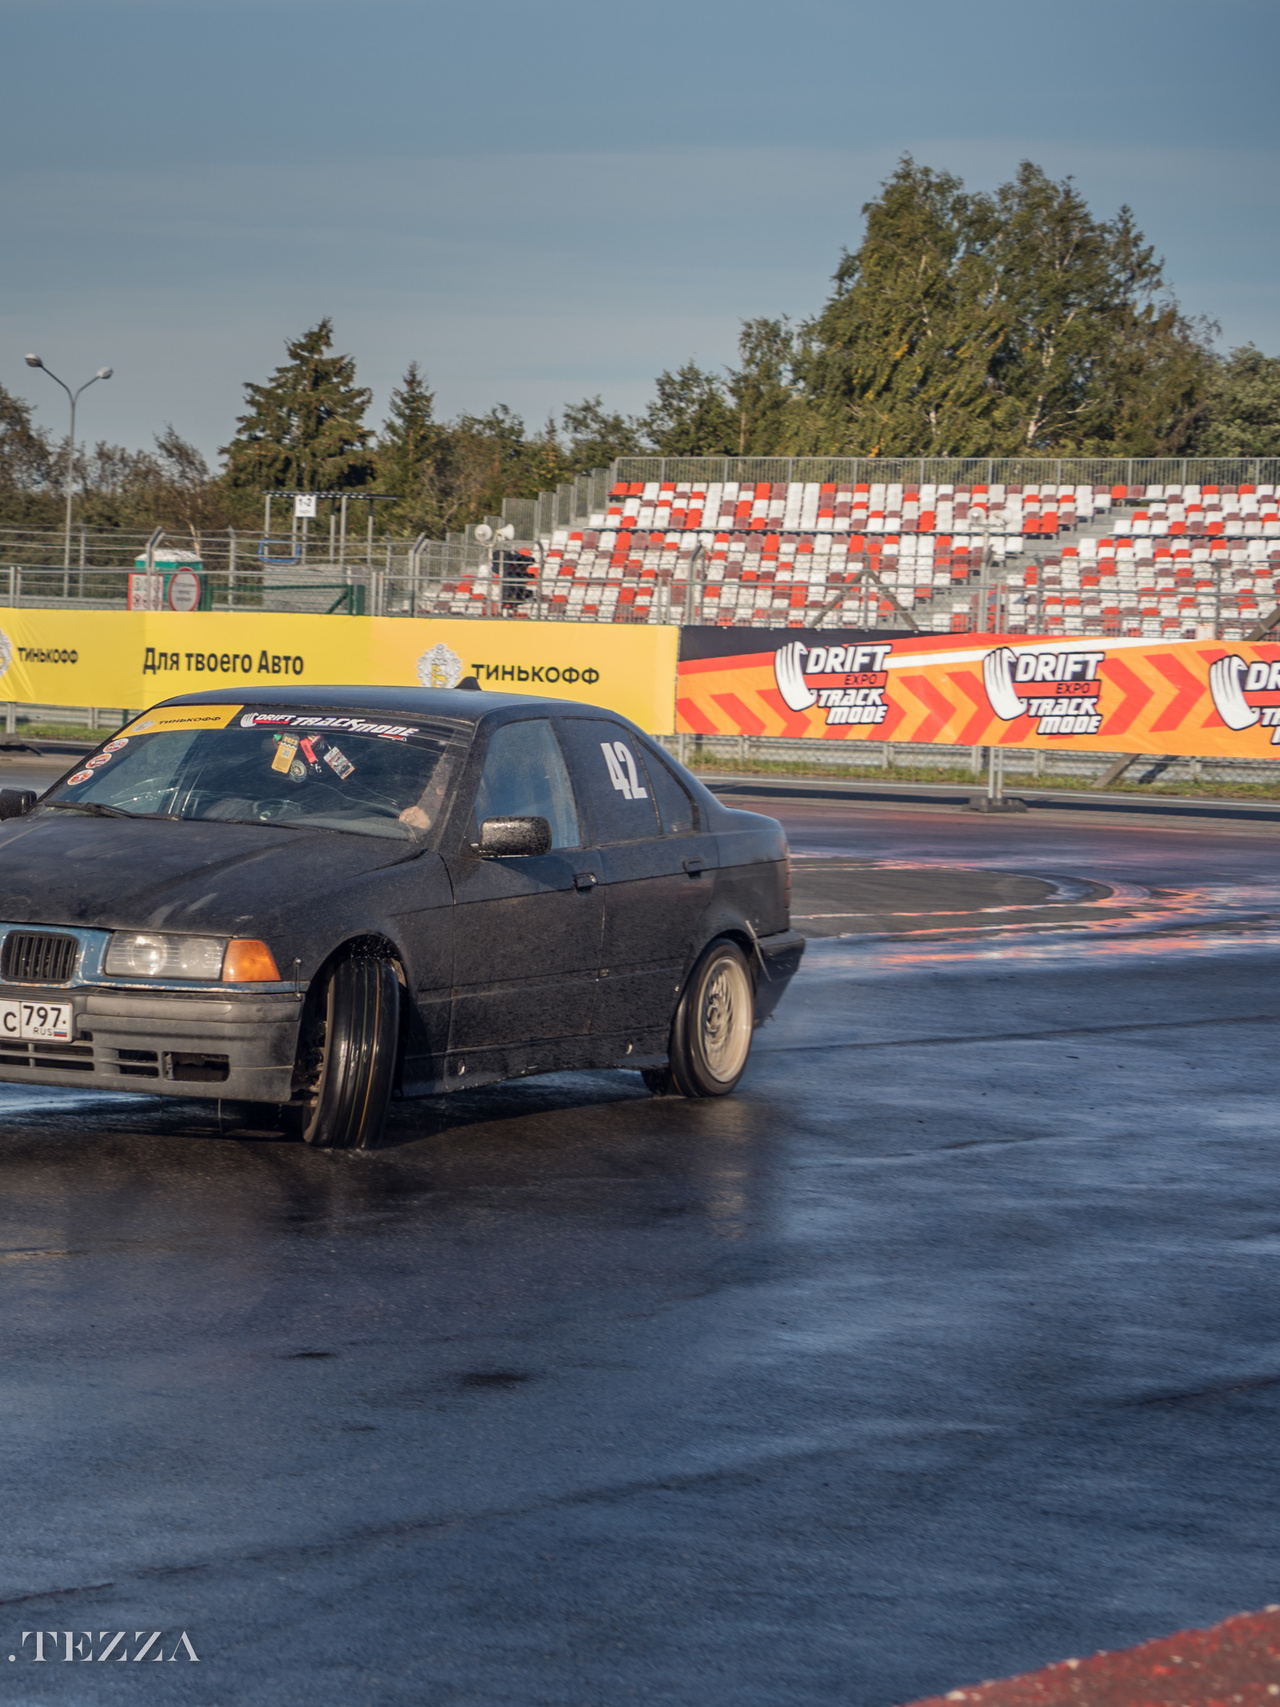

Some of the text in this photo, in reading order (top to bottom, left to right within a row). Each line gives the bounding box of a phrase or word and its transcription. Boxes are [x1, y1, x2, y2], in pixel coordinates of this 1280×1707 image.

[17, 647, 78, 664] ТИНЬКОФФ
[143, 647, 304, 675] Для твоего Авто
[805, 644, 893, 673] DRIFT
[1015, 651, 1105, 682] DRIFT
[471, 663, 600, 684] ТИНЬКОФФ
[845, 674, 877, 685] EXPO
[1056, 683, 1090, 694] EXPO
[600, 741, 649, 799] 42
[23, 1005, 62, 1028] 797
[33, 1027, 53, 1036] RUS
